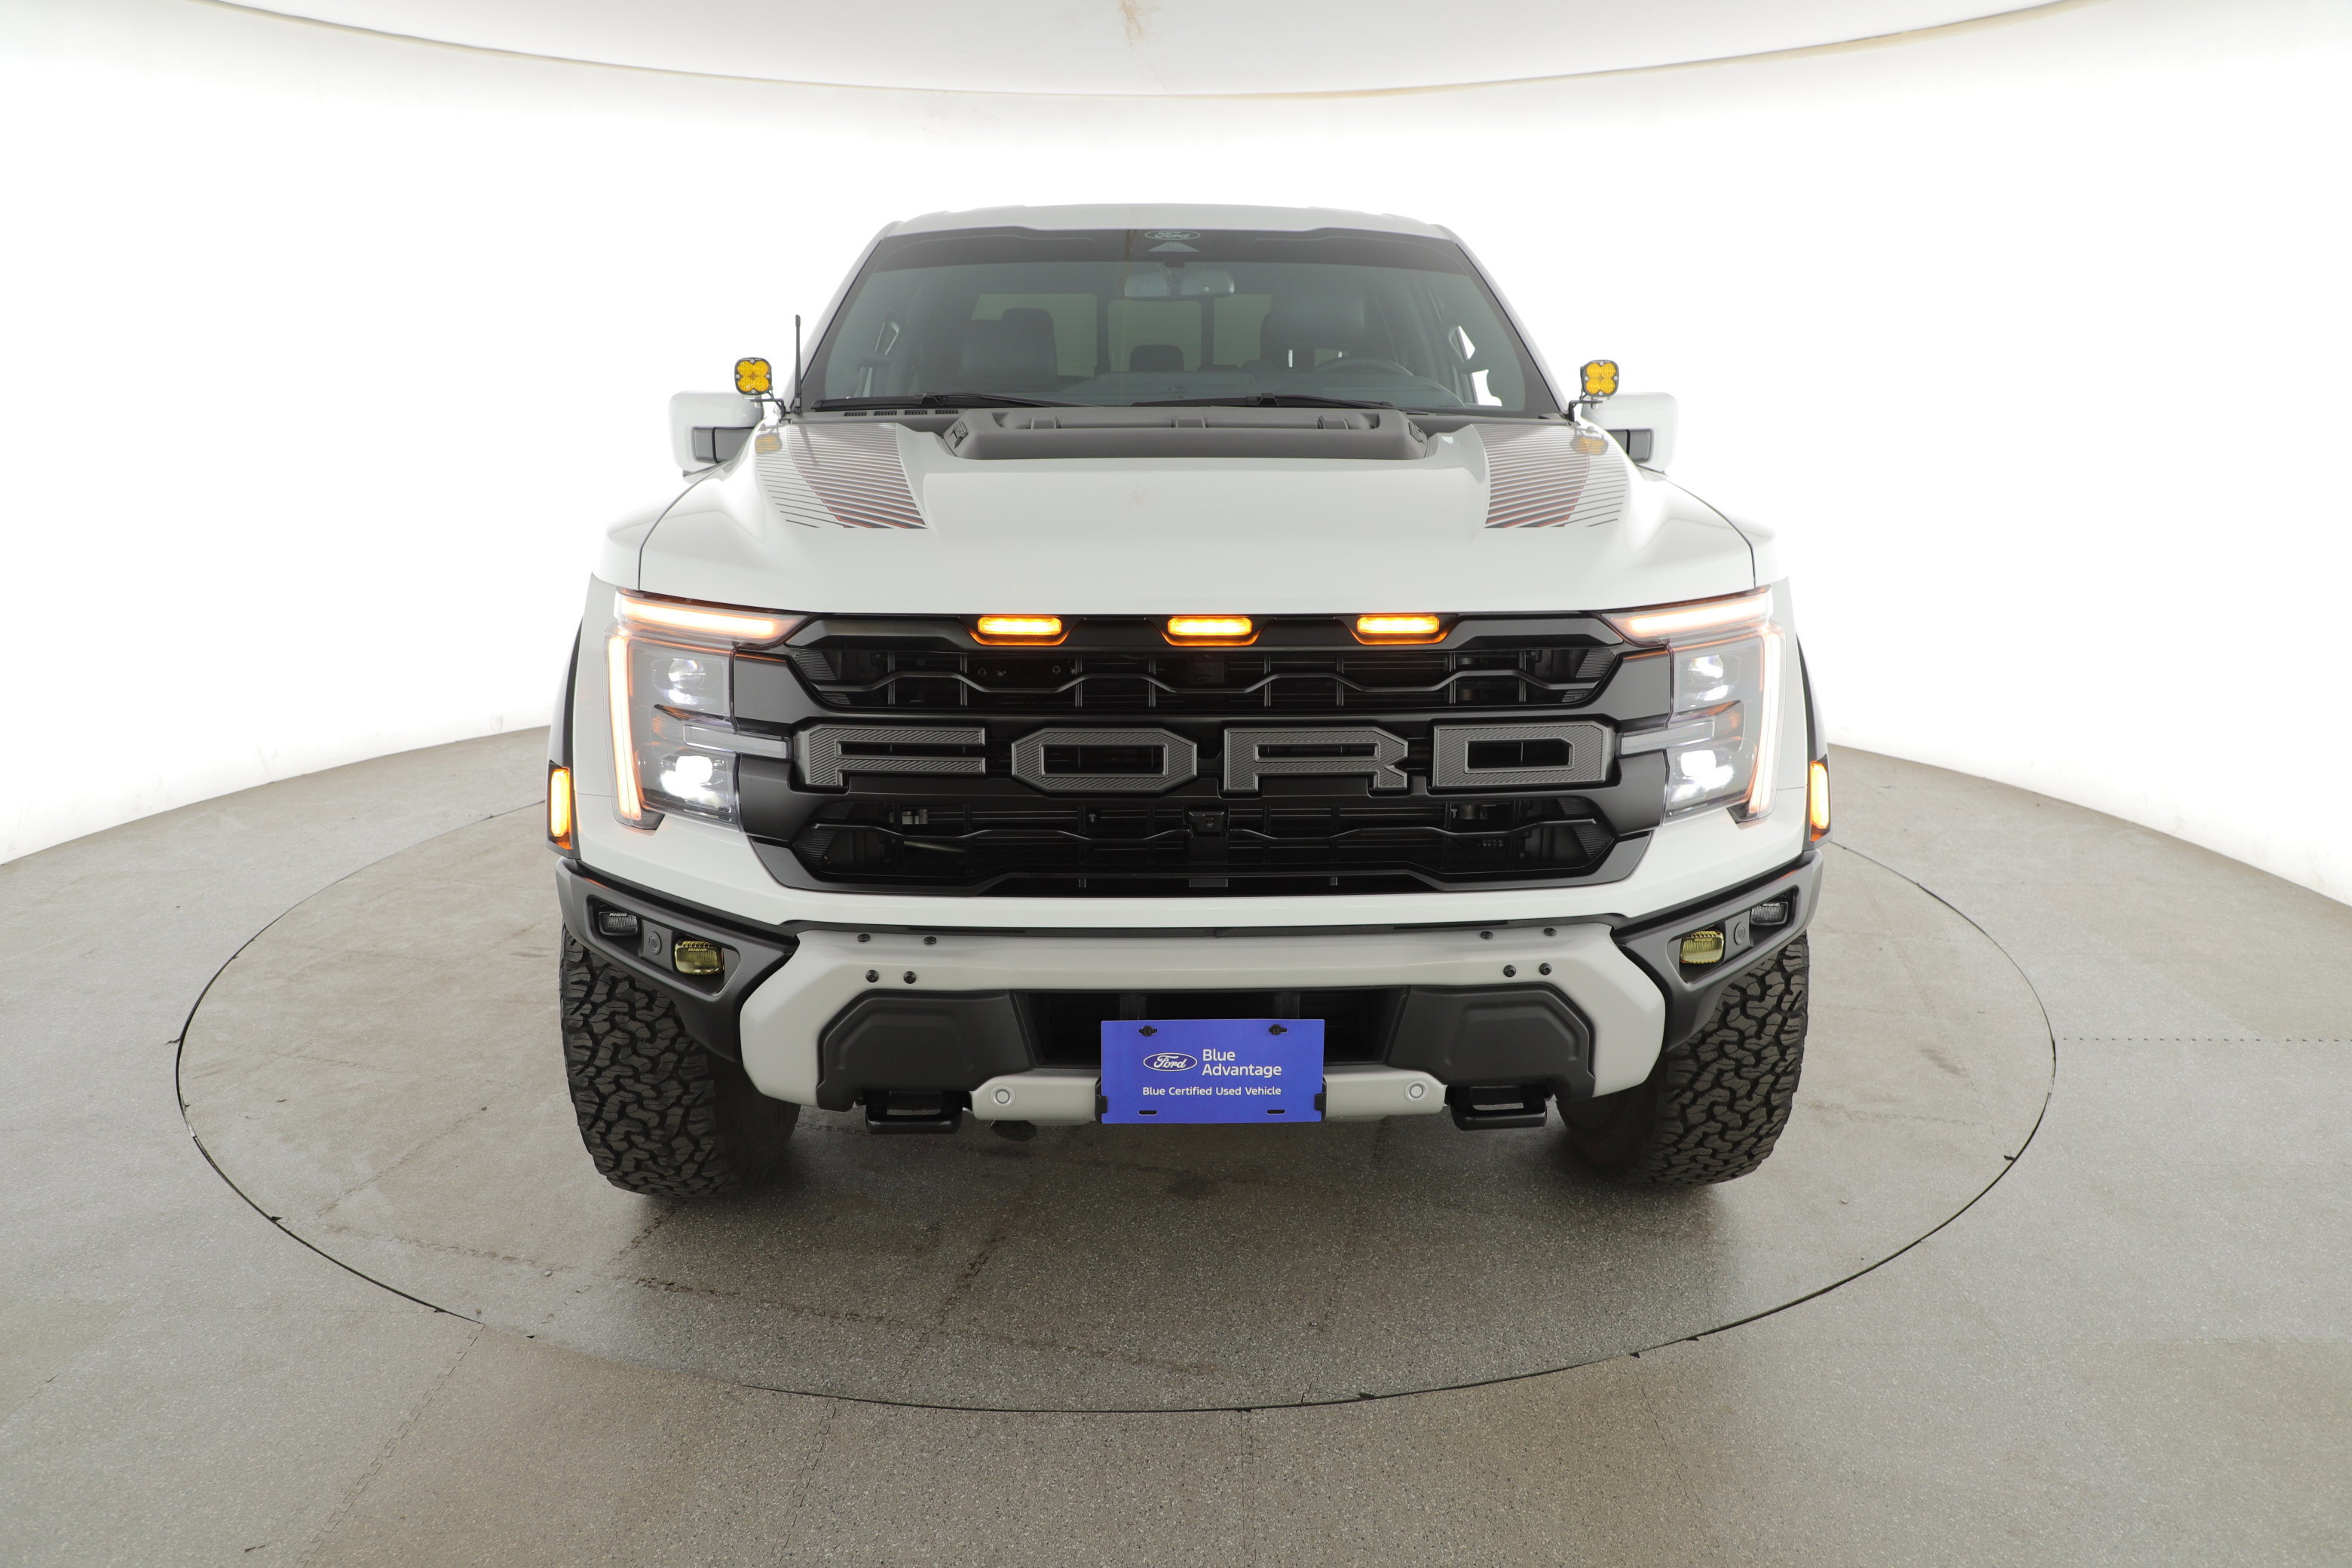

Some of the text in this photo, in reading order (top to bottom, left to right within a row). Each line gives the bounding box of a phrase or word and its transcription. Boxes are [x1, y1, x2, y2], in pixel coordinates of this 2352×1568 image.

[1154, 229, 1191, 238] Ford
[799, 721, 1612, 793] FORD
[1202, 1048, 1236, 1061] Blue
[1153, 1055, 1187, 1068] Ford
[1202, 1063, 1282, 1079] Advantage
[1142, 1086, 1282, 1095] Blue Certified Used Vehicle
